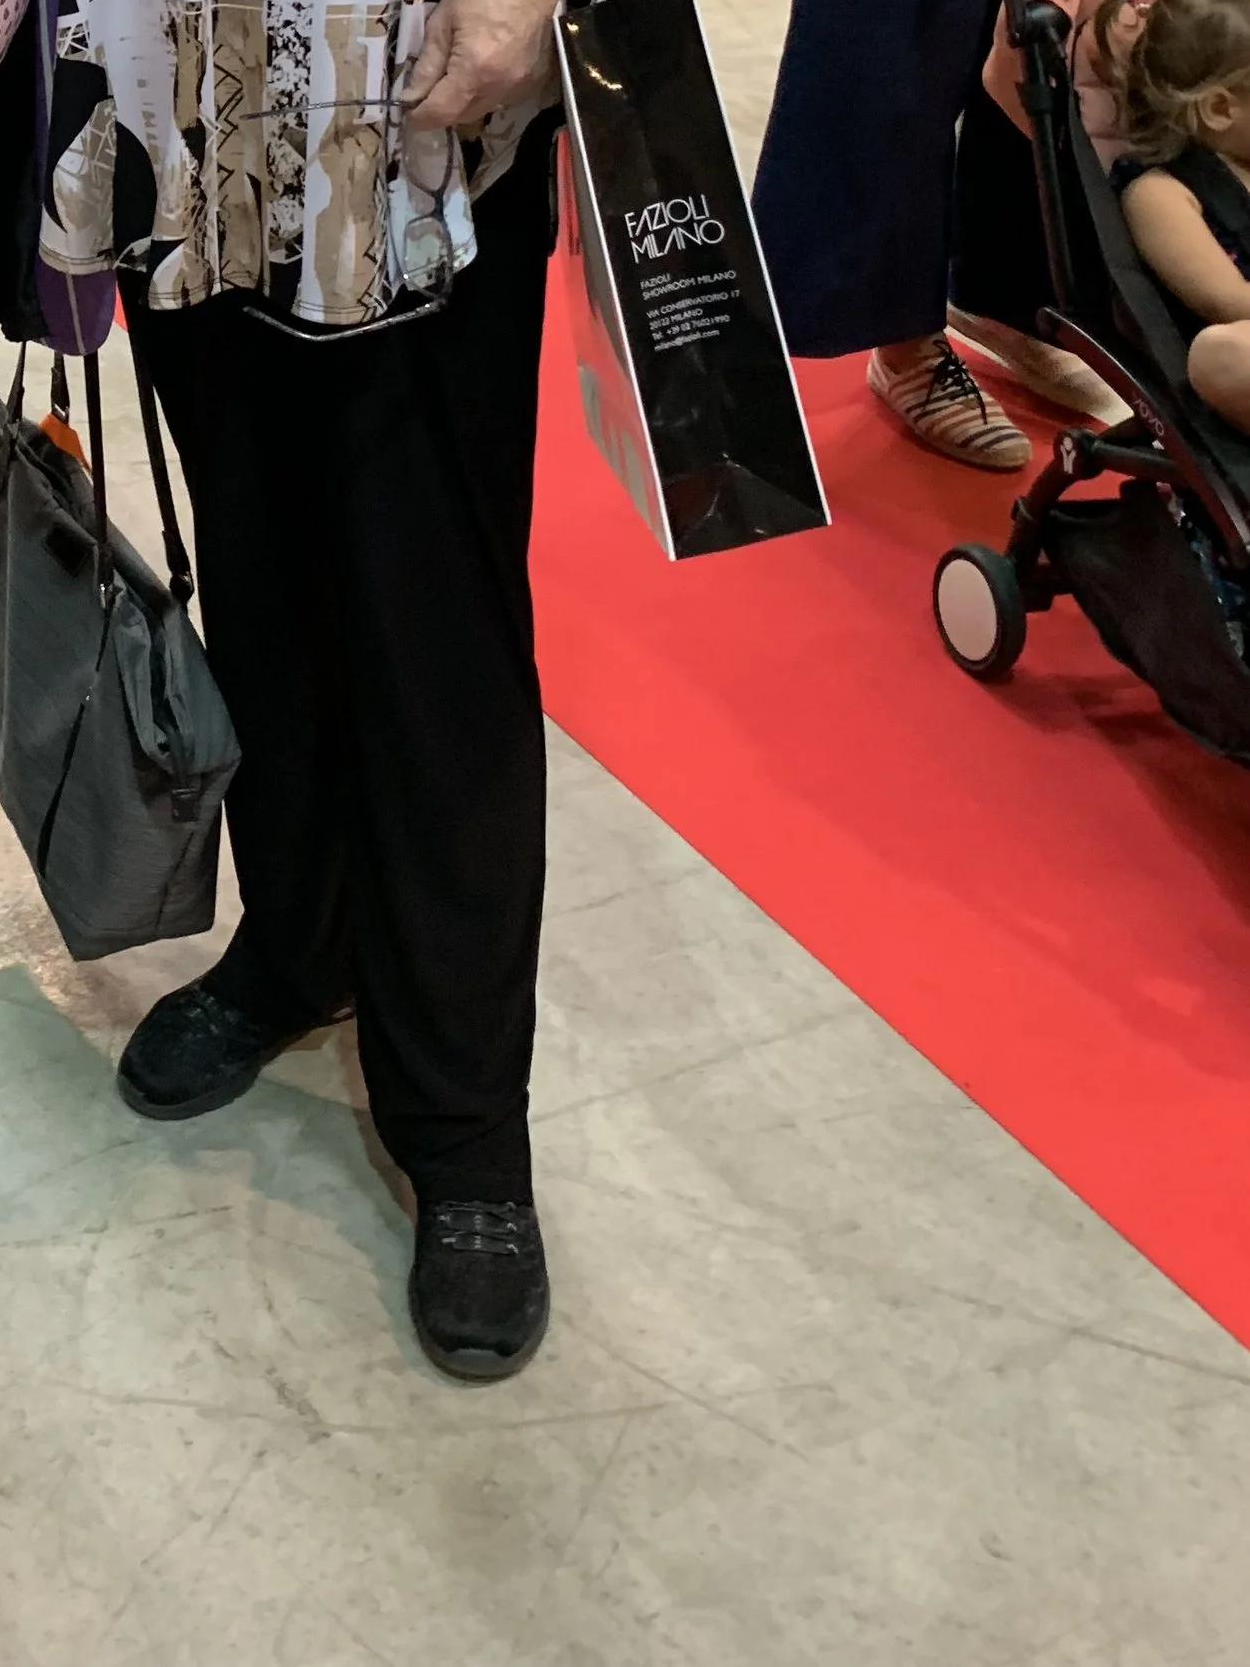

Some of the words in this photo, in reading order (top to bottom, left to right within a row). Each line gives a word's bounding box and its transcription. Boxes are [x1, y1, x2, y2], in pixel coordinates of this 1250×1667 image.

[624, 194, 710, 238] FAZIOLI
[631, 219, 725, 264] MILANO
[640, 273, 671, 290] FAZIOLI
[642, 277, 696, 301] SHOWROOM
[697, 270, 737, 285] MILANO
[646, 309, 660, 319] VIA
[661, 292, 729, 314] CONSERVATORIO
[731, 290, 740, 298] 17
[671, 308, 703, 323] MILANO
[1132, 391, 1165, 435] YOYO
